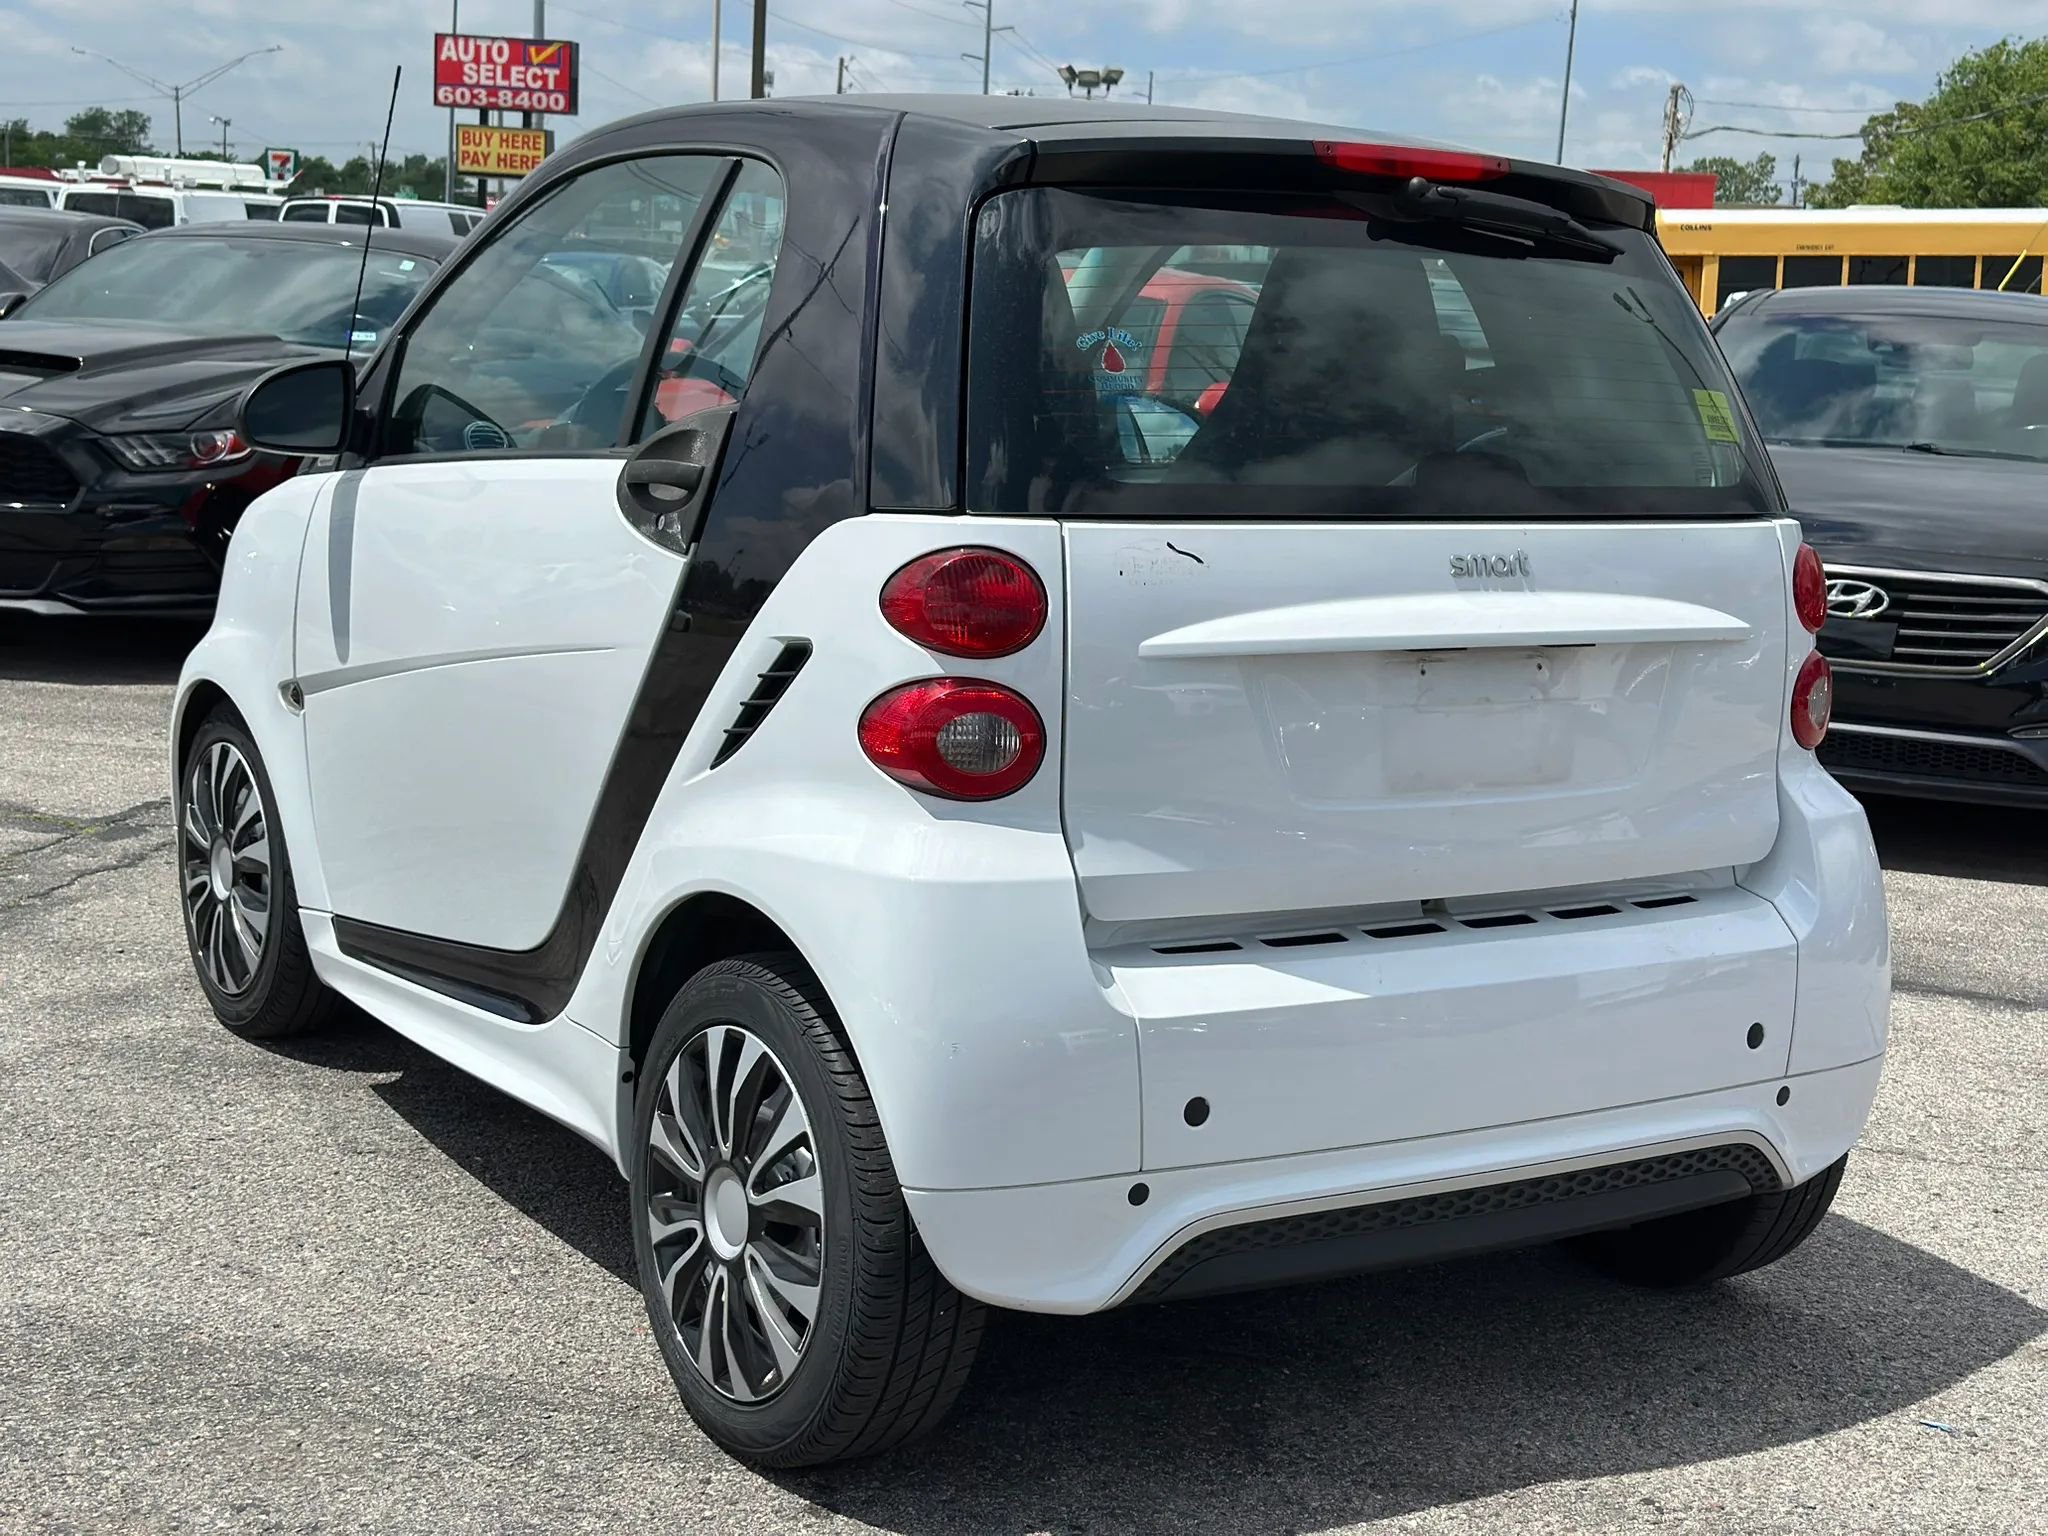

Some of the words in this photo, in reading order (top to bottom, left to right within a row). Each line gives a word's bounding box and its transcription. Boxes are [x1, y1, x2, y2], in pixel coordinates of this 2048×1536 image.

[441, 36, 510, 64] AUTO
[462, 63, 560, 90] SELECT
[437, 86, 566, 111] 603-8400
[461, 130, 494, 148] BUY
[499, 134, 542, 151] HERE
[461, 151, 491, 167] PAY
[1076, 331, 1106, 351] Give
[1449, 547, 1530, 578] smart
